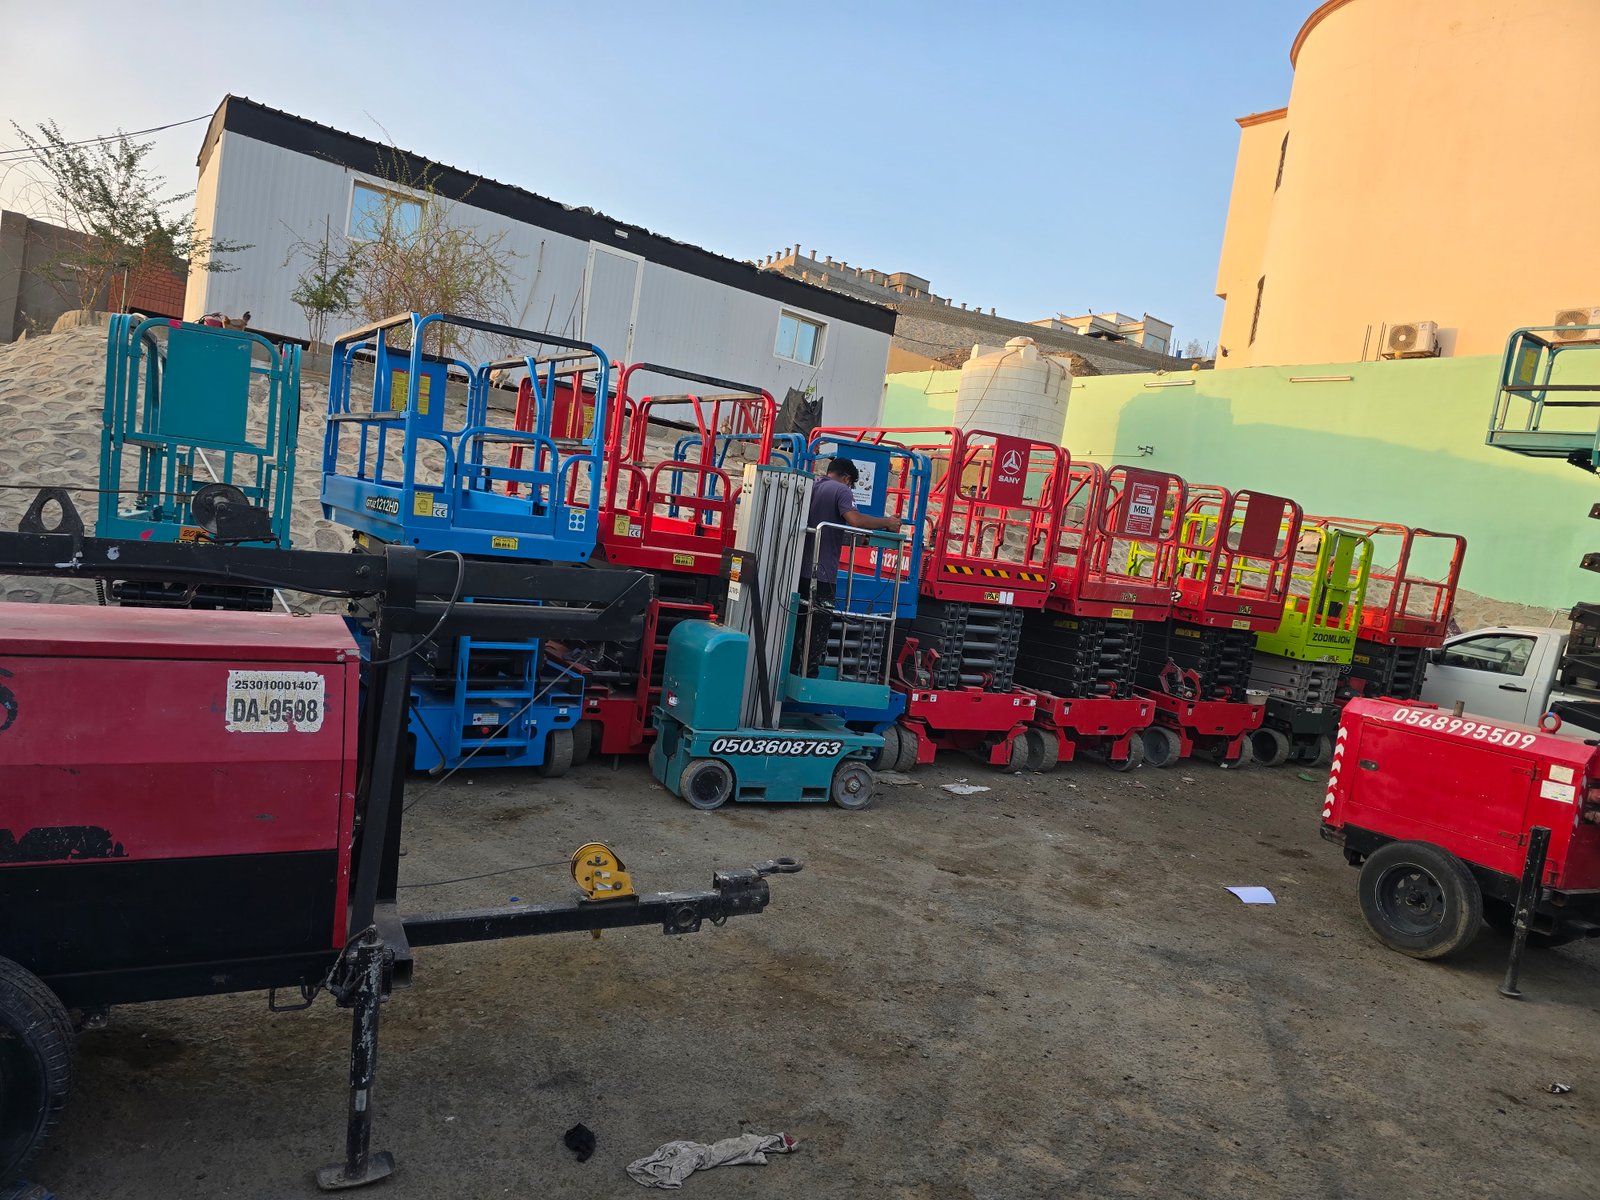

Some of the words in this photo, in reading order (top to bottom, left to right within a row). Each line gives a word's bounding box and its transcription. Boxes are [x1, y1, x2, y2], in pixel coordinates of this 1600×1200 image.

[998, 475, 1020, 485] SANY
[1133, 504, 1151, 516] MBL
[1312, 632, 1351, 645] ZOOMLION
[234, 680, 319, 691] 253010001407
[1392, 708, 1536, 749] 0568995509
[712, 738, 841, 755] 0503608763
